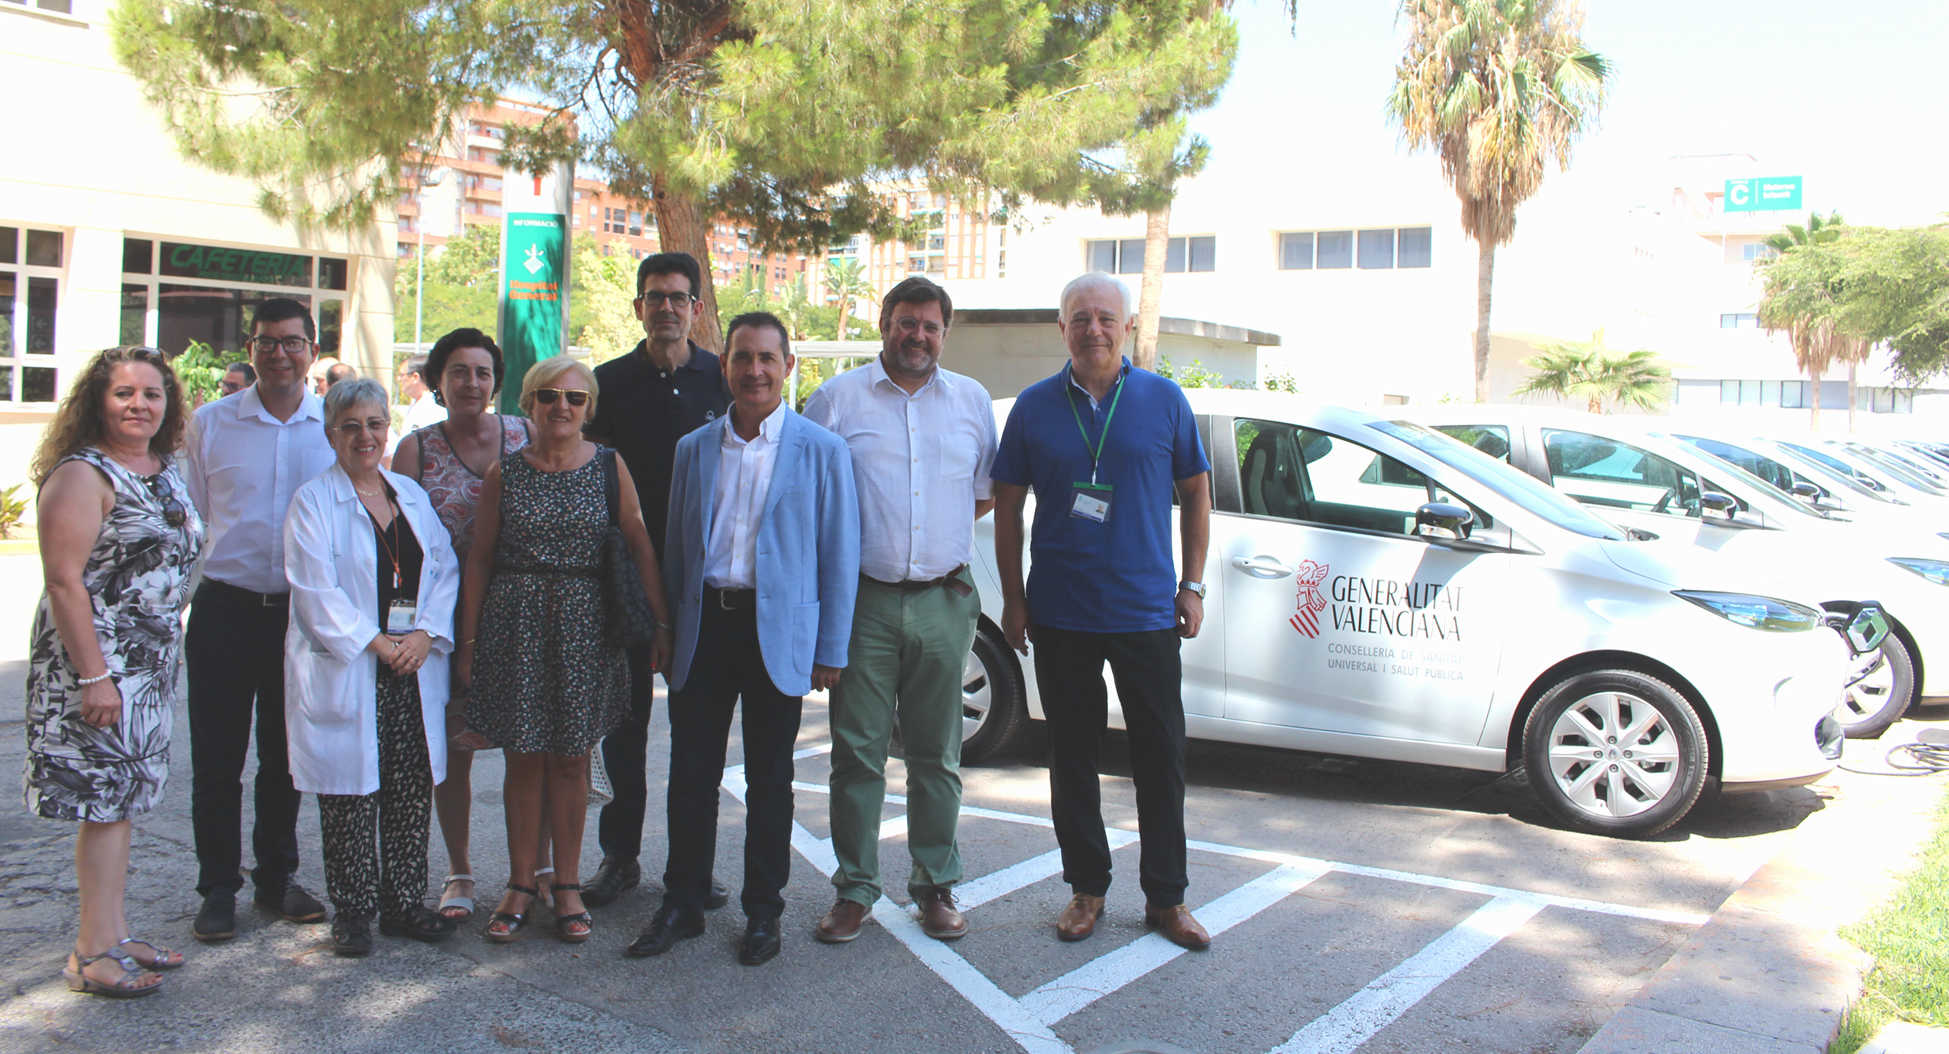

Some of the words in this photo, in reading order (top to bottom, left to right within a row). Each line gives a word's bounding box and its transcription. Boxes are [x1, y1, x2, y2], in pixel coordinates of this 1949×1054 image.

[1731, 184, 1749, 205] C
[170, 245, 305, 277] CAFETERIA
[509, 290, 558, 301] General
[510, 280, 558, 291] Hospital
[1331, 575, 1464, 612] GENERALITAT
[1331, 602, 1461, 642] VALENCIANA
[1328, 642, 1395, 658] CONSELLERIA
[1400, 649, 1416, 660] DE
[1328, 658, 1377, 673] UNIVERSAL
[1391, 664, 1420, 677] SALUT
